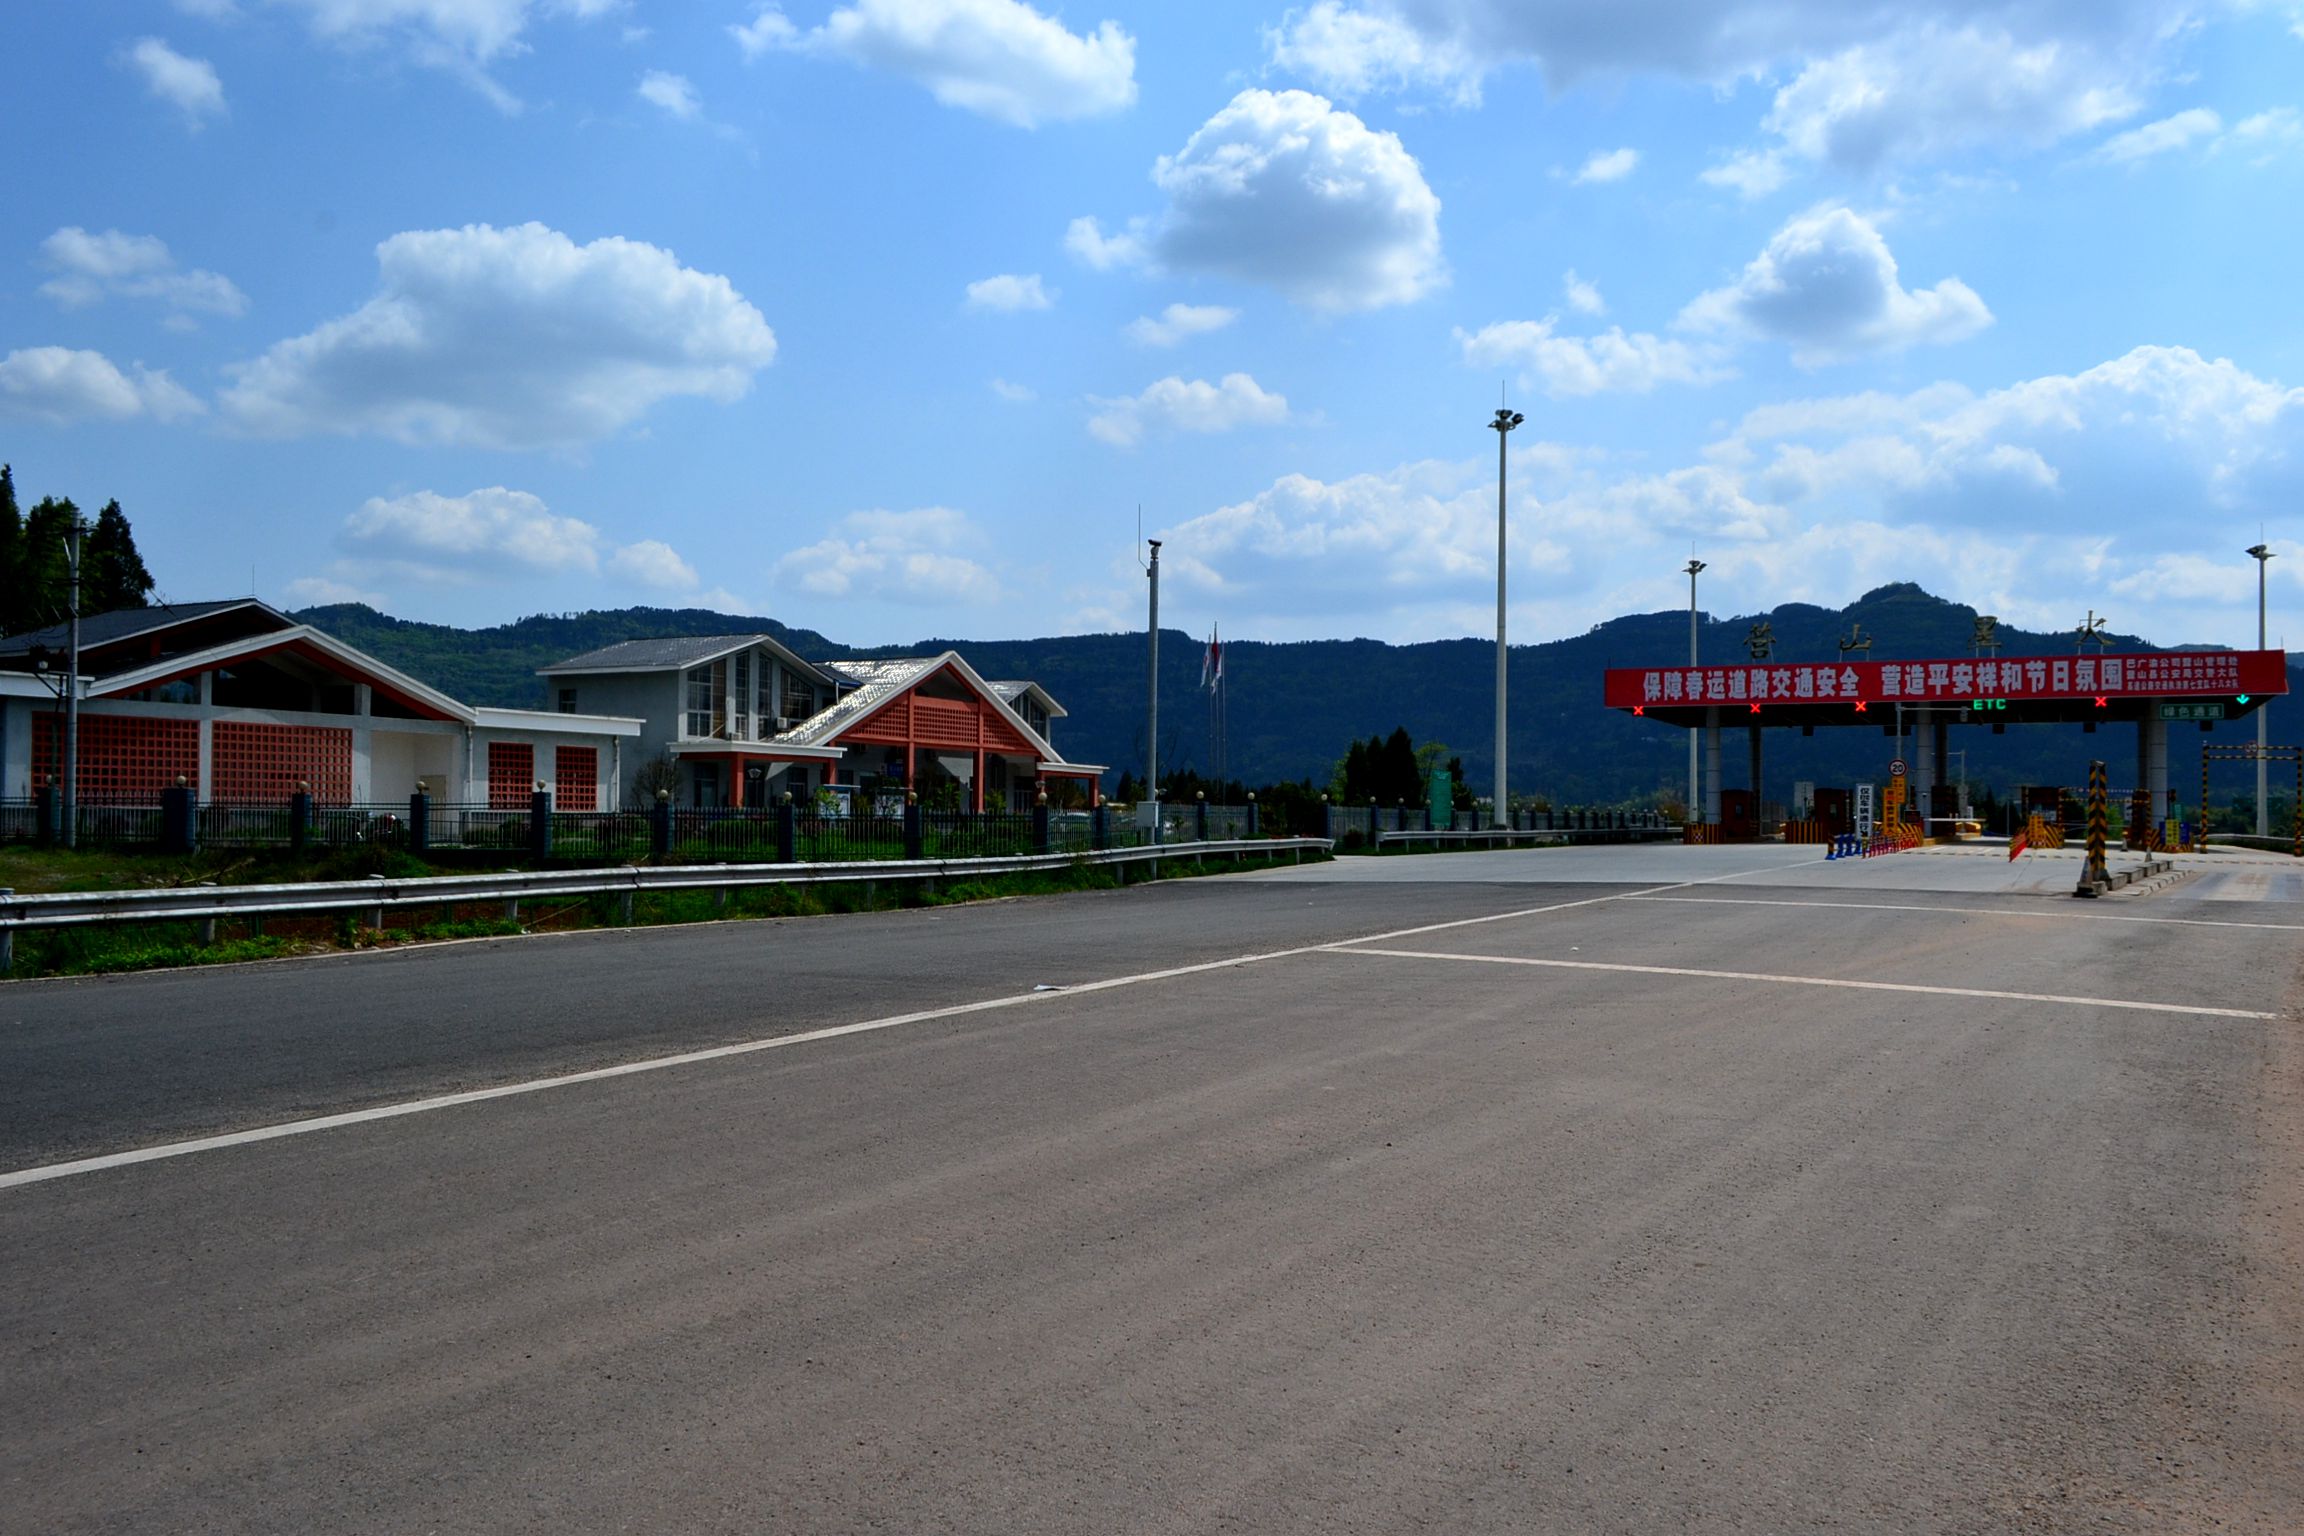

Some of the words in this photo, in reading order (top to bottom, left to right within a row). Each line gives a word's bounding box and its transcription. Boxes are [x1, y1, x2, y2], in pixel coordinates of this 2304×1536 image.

[1644, 667, 1860, 701] 保障春运道路交通安全
[1881, 658, 2123, 696] 营造平安祥和节日氛围
[1972, 699, 2007, 711] ETC
[1892, 764, 1904, 773] 20
